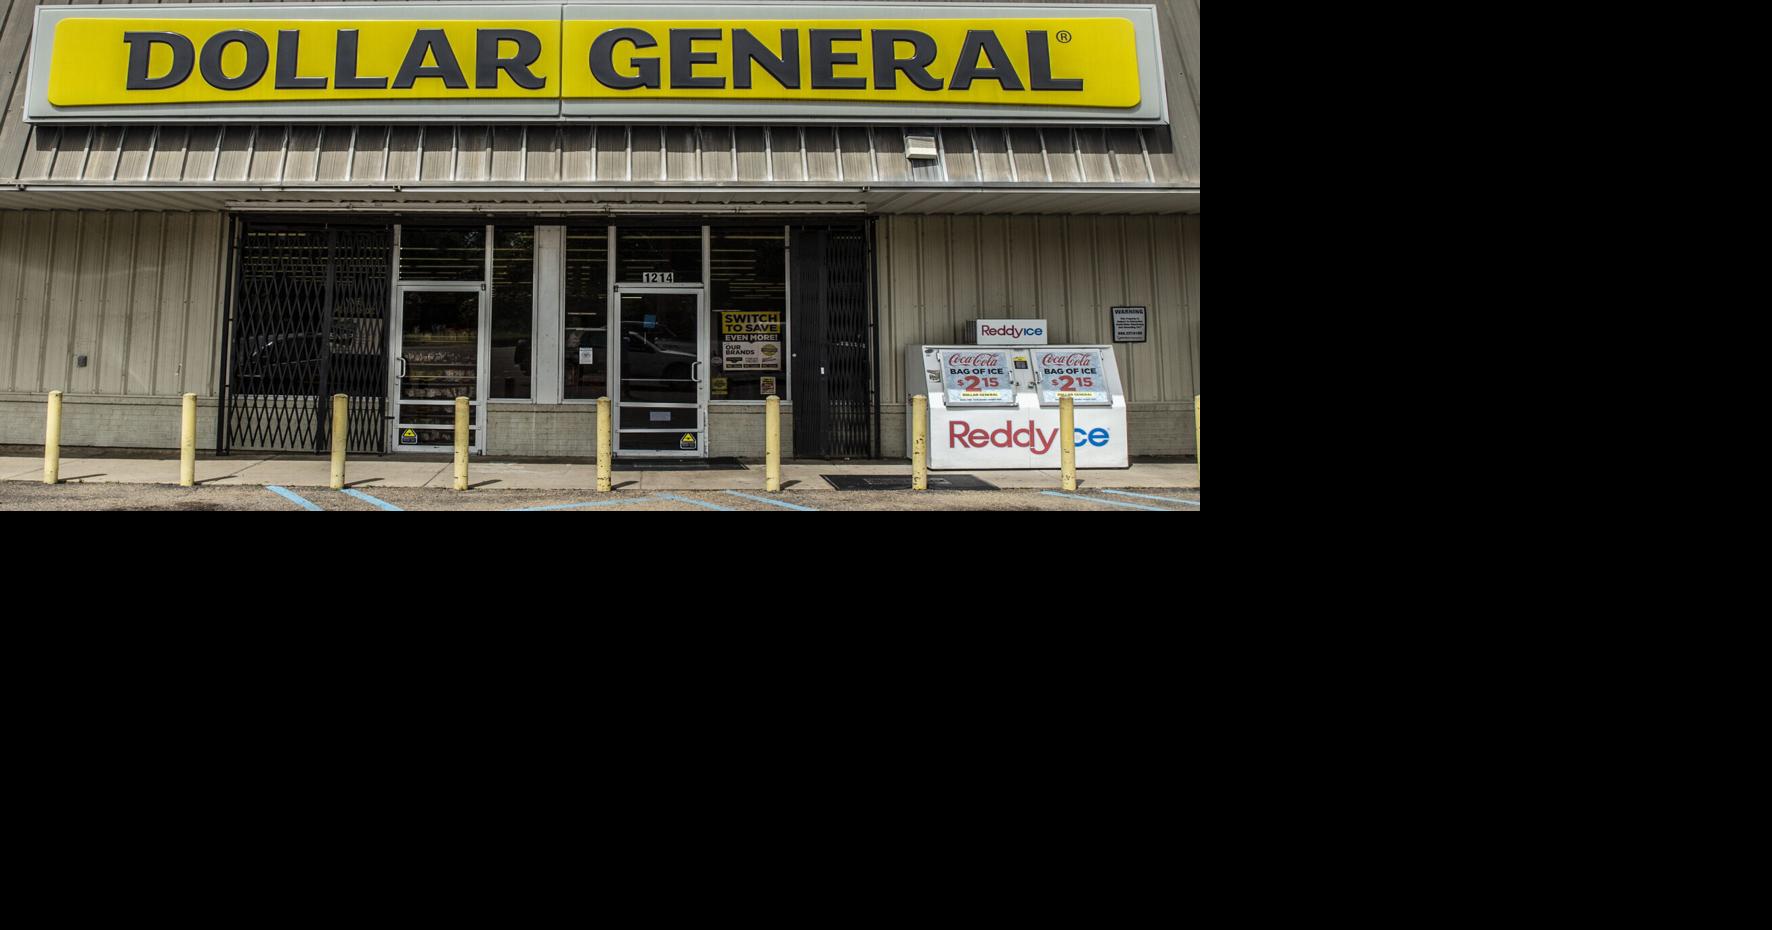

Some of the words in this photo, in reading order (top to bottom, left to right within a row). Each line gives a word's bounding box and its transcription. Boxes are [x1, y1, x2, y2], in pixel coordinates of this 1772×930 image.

[123, 28, 547, 91] DOLLAR
[588, 27, 1084, 92] GENERAL
[644, 272, 673, 283] 1214
[724, 314, 777, 323] SWITCH
[725, 324, 743, 332] TO
[745, 324, 778, 332] SAVE
